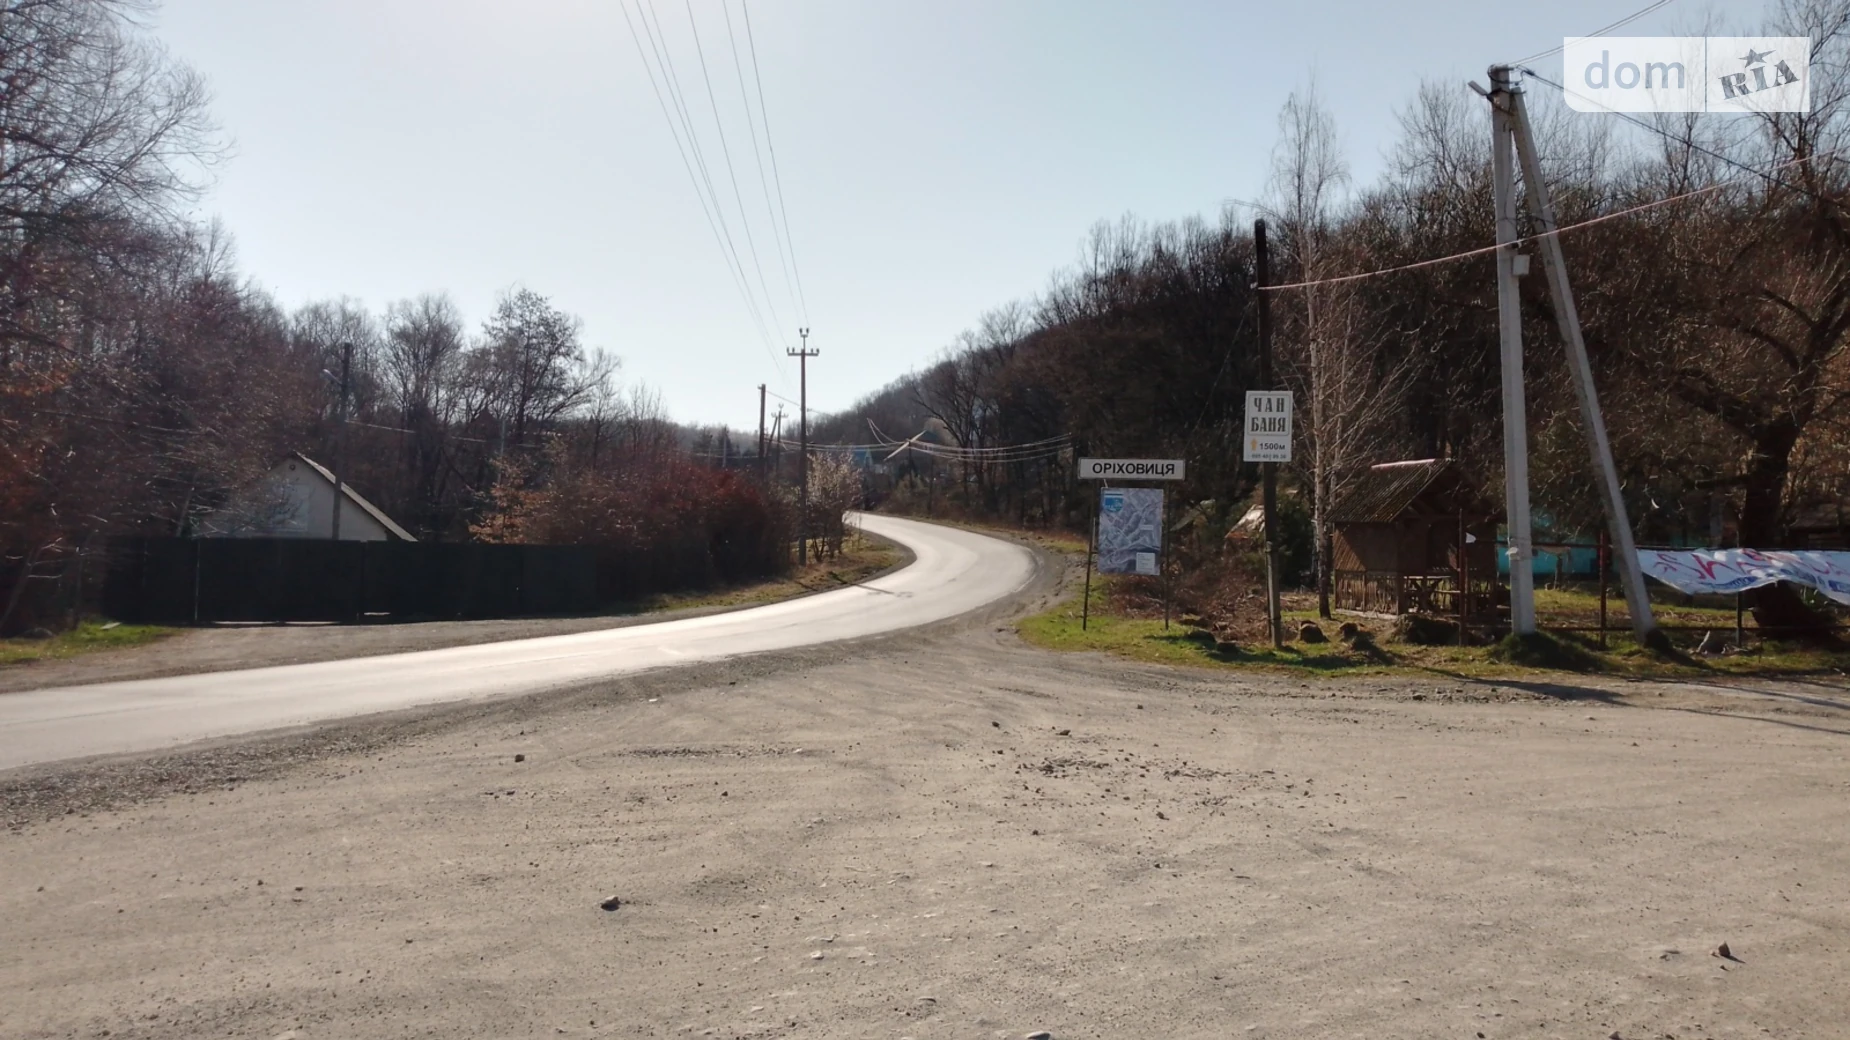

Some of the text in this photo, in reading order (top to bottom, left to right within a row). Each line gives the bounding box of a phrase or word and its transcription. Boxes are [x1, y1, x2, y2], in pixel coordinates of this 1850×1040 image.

[1253, 397, 1285, 413] ЧАН
[1250, 417, 1286, 432] БАНЯ
[1259, 442, 1286, 450] 1500м
[1092, 462, 1175, 476] ОРІХОВИЦЯ
